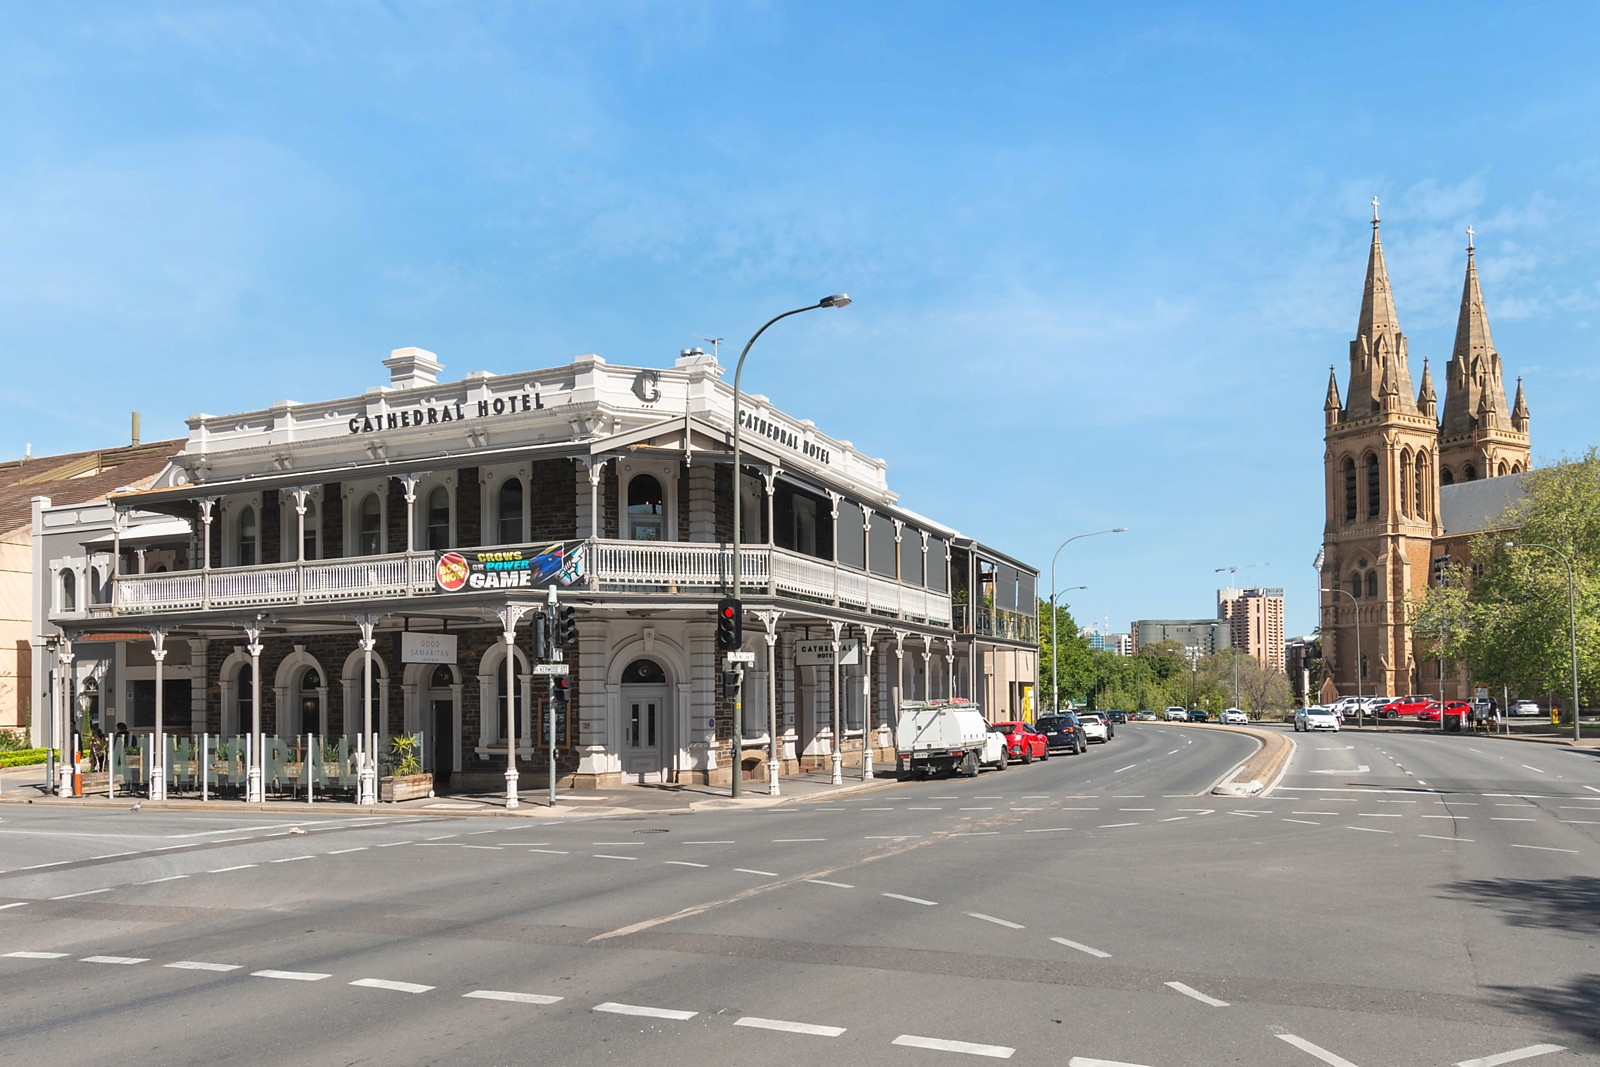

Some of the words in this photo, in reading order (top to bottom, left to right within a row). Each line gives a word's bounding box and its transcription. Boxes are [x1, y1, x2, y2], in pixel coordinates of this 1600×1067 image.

[348, 403, 465, 434] CATHEDRAL
[477, 392, 545, 417] HOTEL
[738, 409, 799, 450] CATHEDRAL
[802, 439, 830, 465] HOTEL
[477, 551, 523, 563] CROWS
[439, 562, 466, 576] BOOK
[472, 563, 485, 571] OR
[485, 559, 530, 571] POWER
[441, 571, 465, 584] NOW
[469, 569, 532, 588] GAME
[420, 640, 440, 648] GOOD
[801, 644, 853, 653] CATHEAL
[410, 649, 449, 657] SAMARITAN
